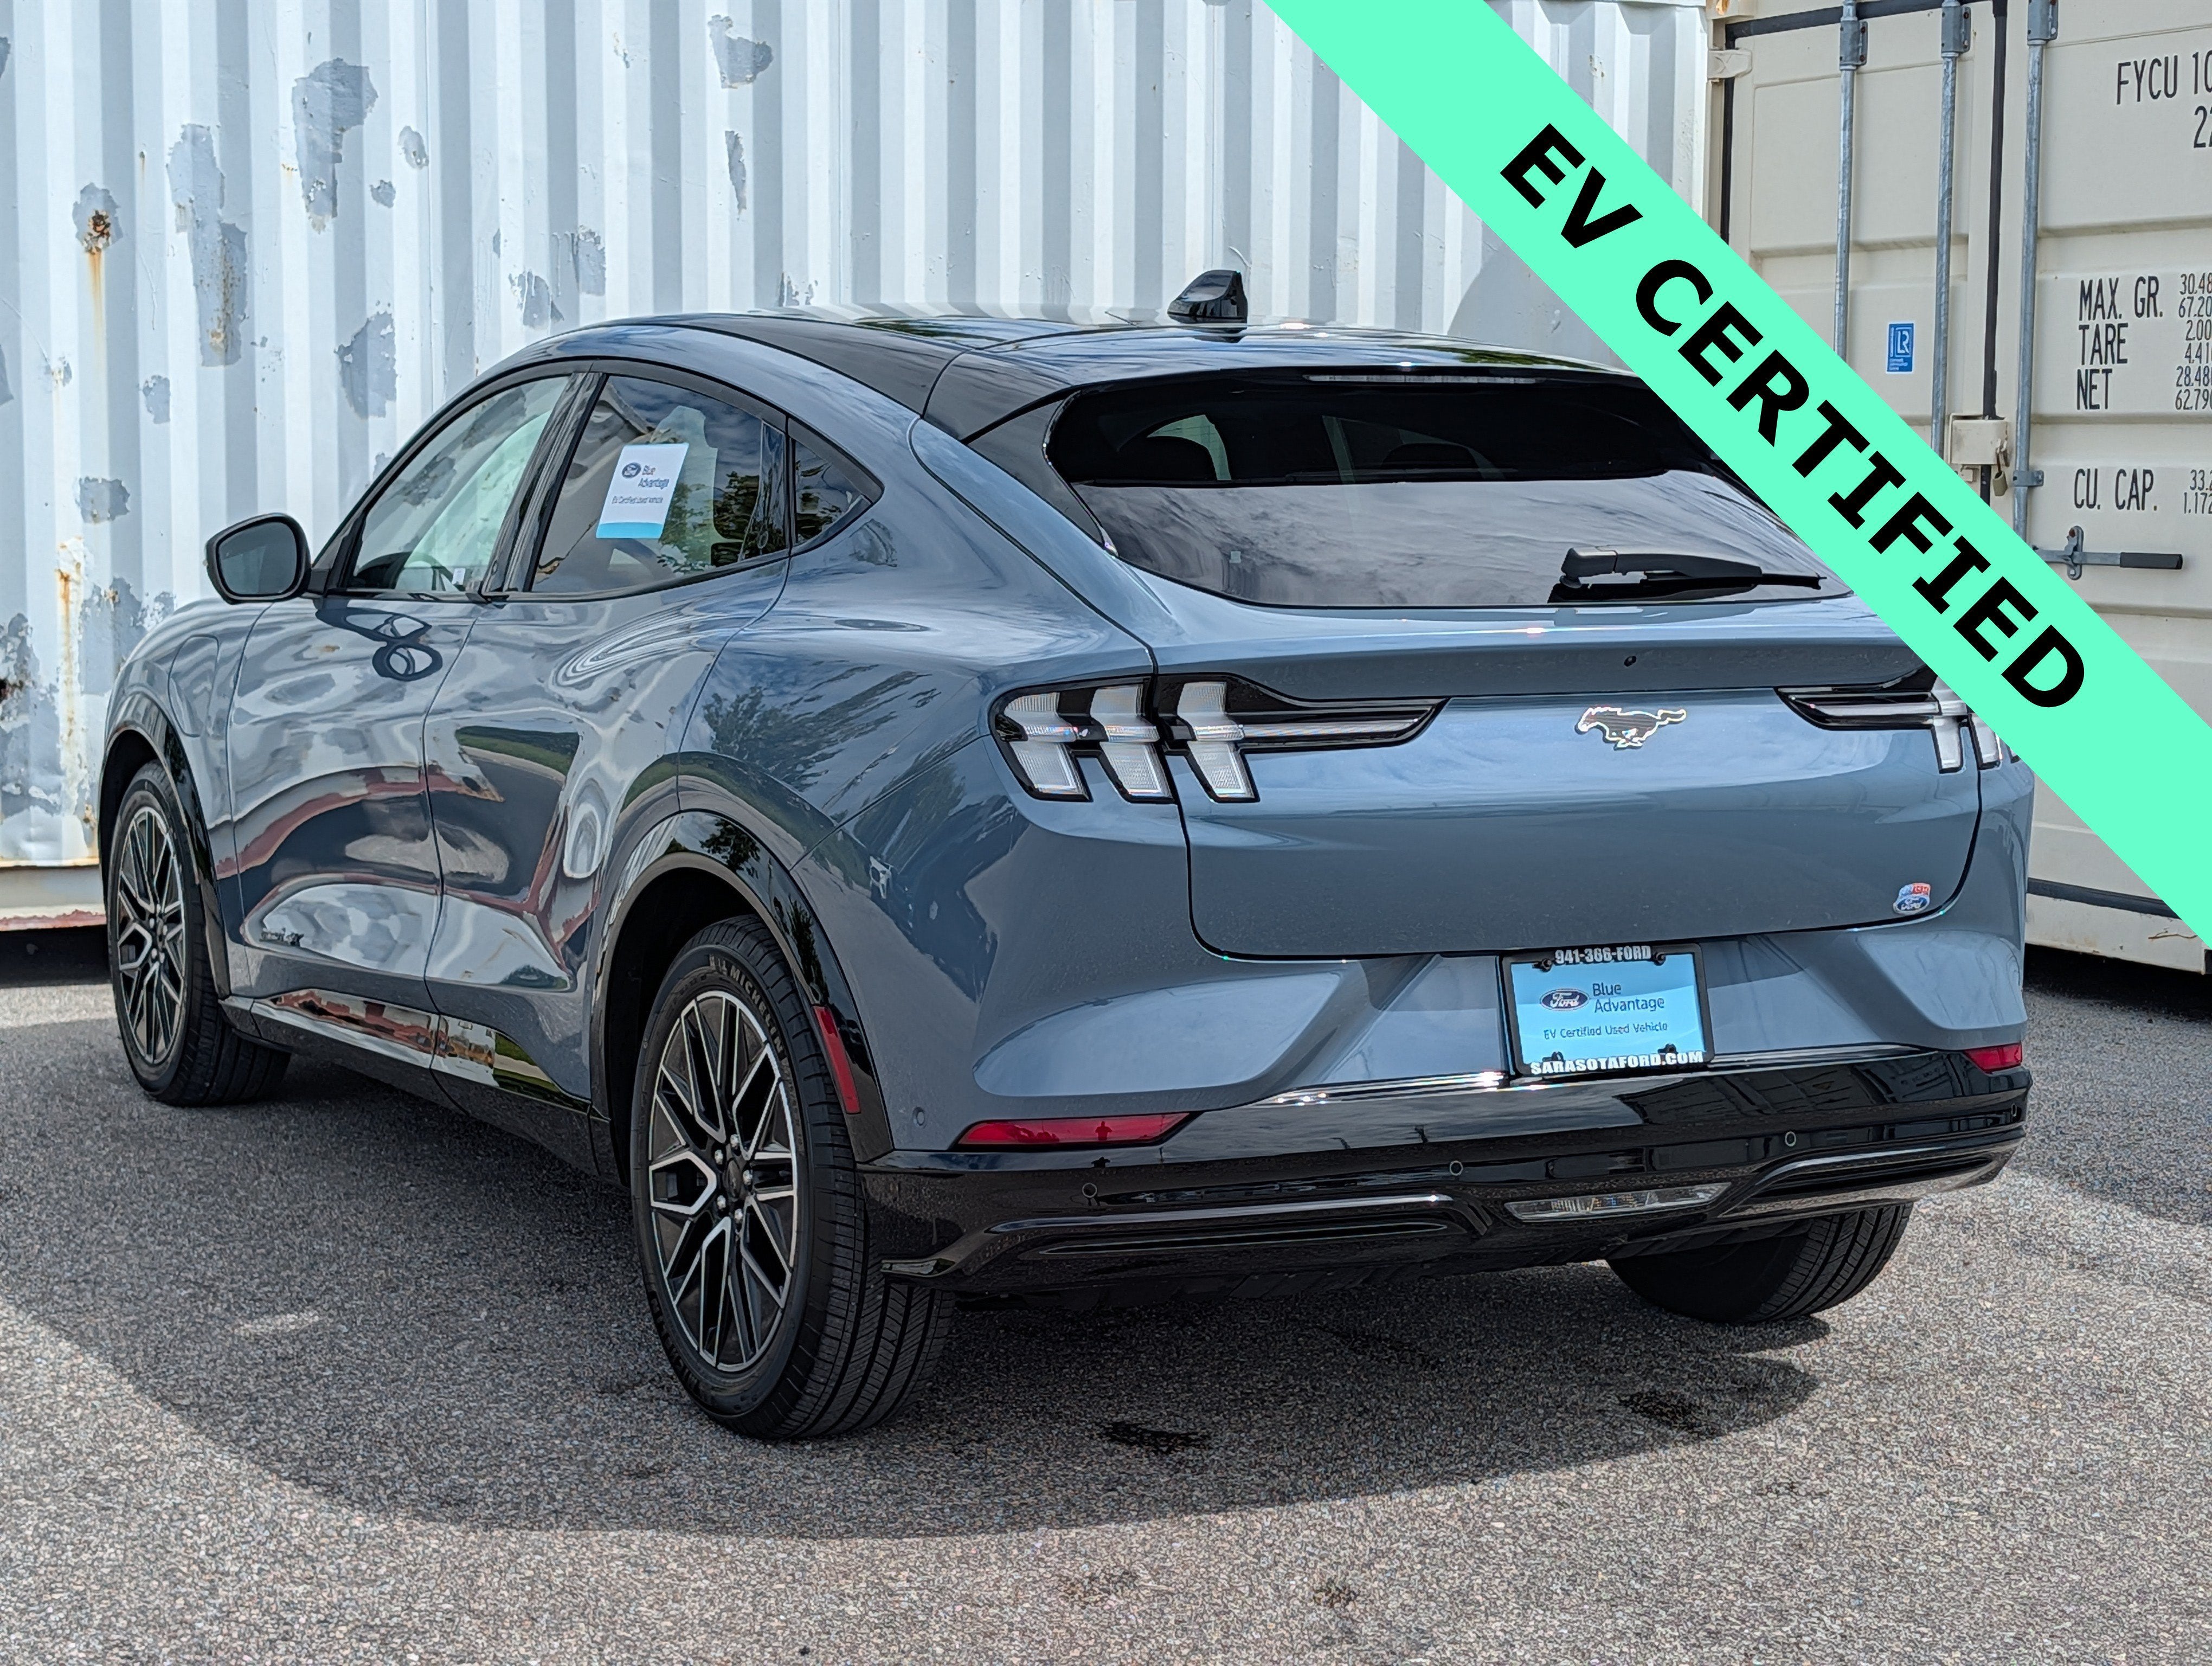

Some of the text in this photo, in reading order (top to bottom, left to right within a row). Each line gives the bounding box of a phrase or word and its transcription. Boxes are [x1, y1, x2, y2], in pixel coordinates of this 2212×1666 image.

[2116, 55, 2178, 105] FYCU
[2194, 105, 2212, 149] 2
[2079, 277, 2122, 321] MAX.
[2134, 275, 2163, 318] GR.
[2078, 323, 2129, 366] TARE
[2076, 368, 2113, 410] NET
[2074, 468, 2101, 510] CU.
[2115, 468, 2157, 510] CAP.
[1592, 982, 1622, 997] Blue
[1594, 996, 1665, 1013] Advantage
[1530, 1050, 1704, 1075] SARASOTAFORD.COM
